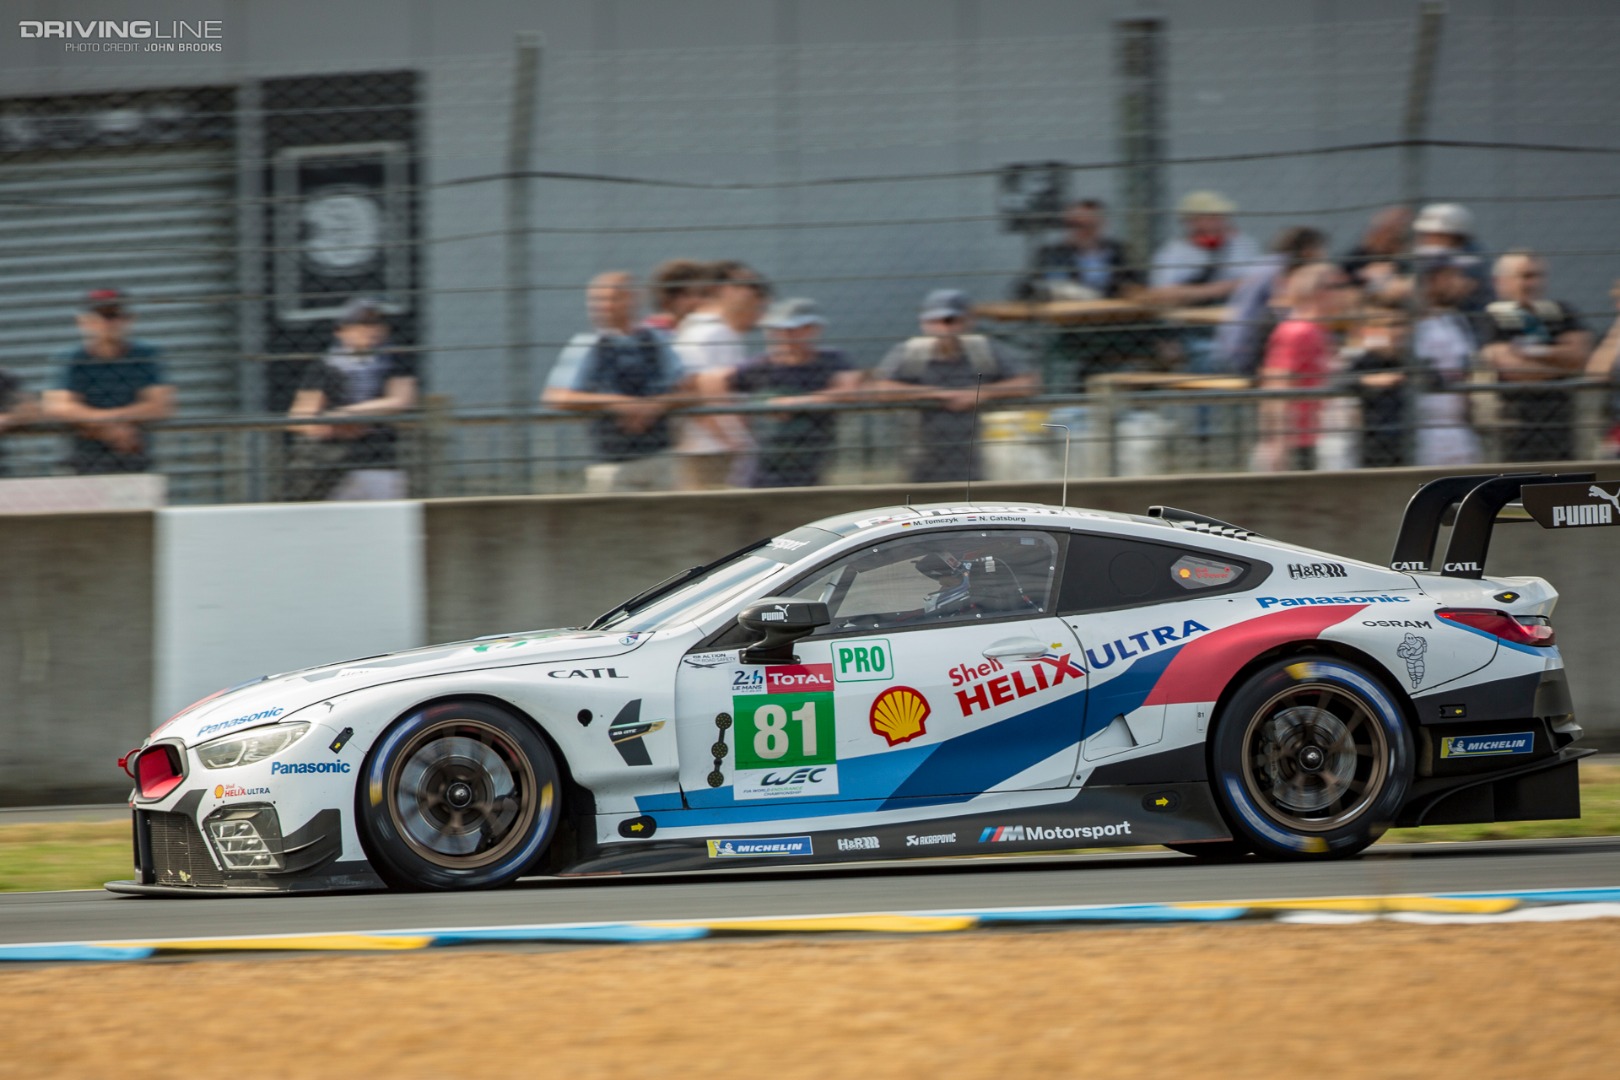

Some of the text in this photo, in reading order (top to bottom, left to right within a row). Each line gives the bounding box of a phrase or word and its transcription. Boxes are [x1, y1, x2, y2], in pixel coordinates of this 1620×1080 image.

[925, 516, 959, 526] Tomczyk
[990, 515, 1026, 523] Catsburg
[1552, 503, 1612, 527] PUMA
[1288, 563, 1328, 580] H&R
[1391, 561, 1429, 571] CATL
[1444, 561, 1482, 572] CATL
[1256, 594, 1410, 609] Panasonic
[761, 612, 785, 621] PUMA
[1362, 620, 1433, 629] OSRAM
[838, 645, 885, 673] PRO
[547, 667, 629, 679] CATL
[948, 656, 1004, 687] Shell
[954, 619, 1211, 718] HELIX ULTRA
[196, 706, 285, 737] Panasonic
[753, 701, 817, 760] 81
[1467, 739, 1526, 751] MICHELIN
[270, 758, 351, 776] Panasonic
[761, 767, 827, 786] WEC
[224, 787, 271, 797] HELIX ULTRA
[1026, 820, 1132, 841] Motorsport
[737, 842, 803, 853] MICHELIN
[837, 837, 867, 851] H&R
